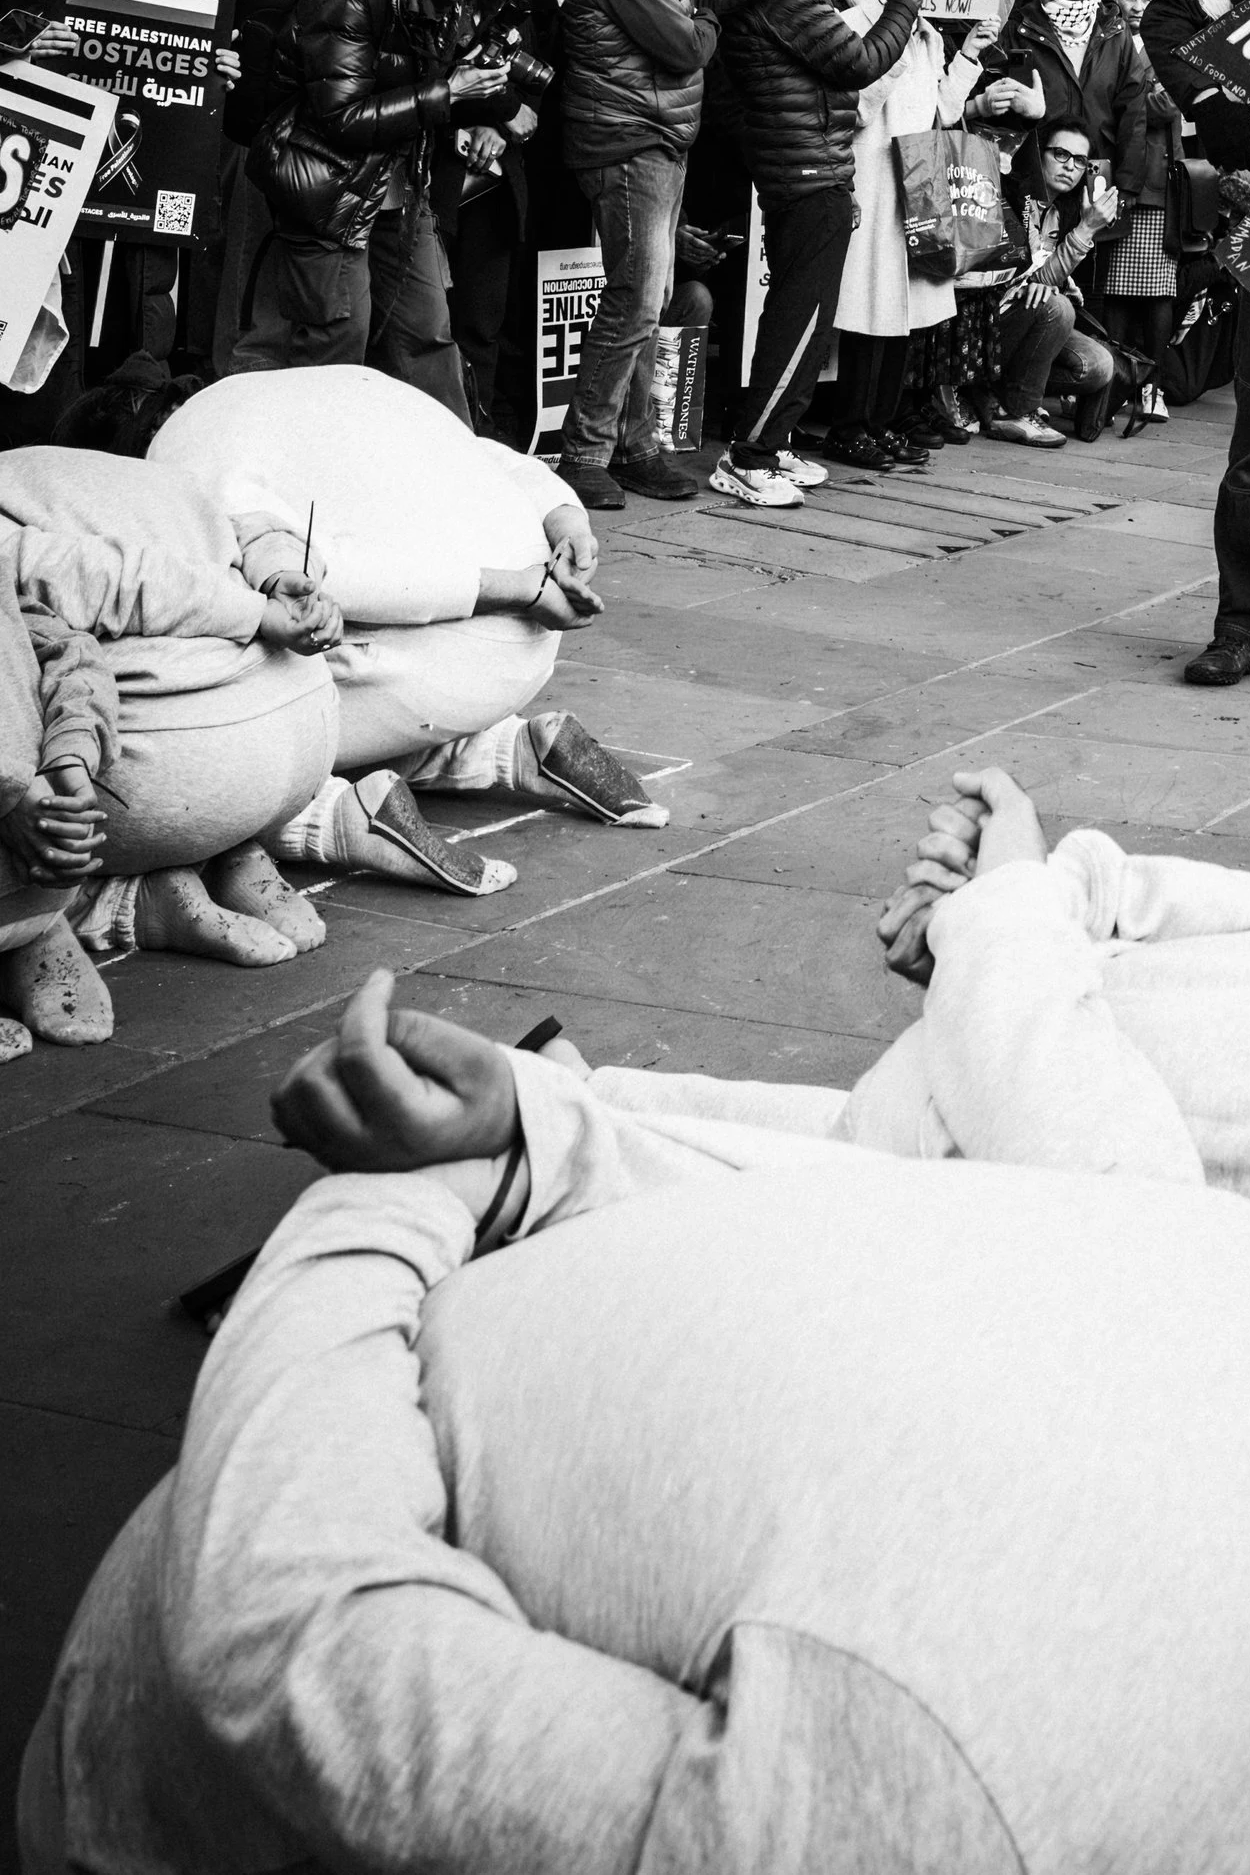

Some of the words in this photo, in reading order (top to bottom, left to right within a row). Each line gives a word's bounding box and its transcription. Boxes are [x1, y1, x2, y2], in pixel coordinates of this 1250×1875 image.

[64, 16, 107, 35] FREE
[111, 24, 212, 52] PALESTINIAN
[1179, 34, 1207, 56] DIRTY
[142, 78, 204, 107] الحرية
[543, 279, 593, 294] OCCUPATION
[678, 337, 700, 440] WATERSTONES
